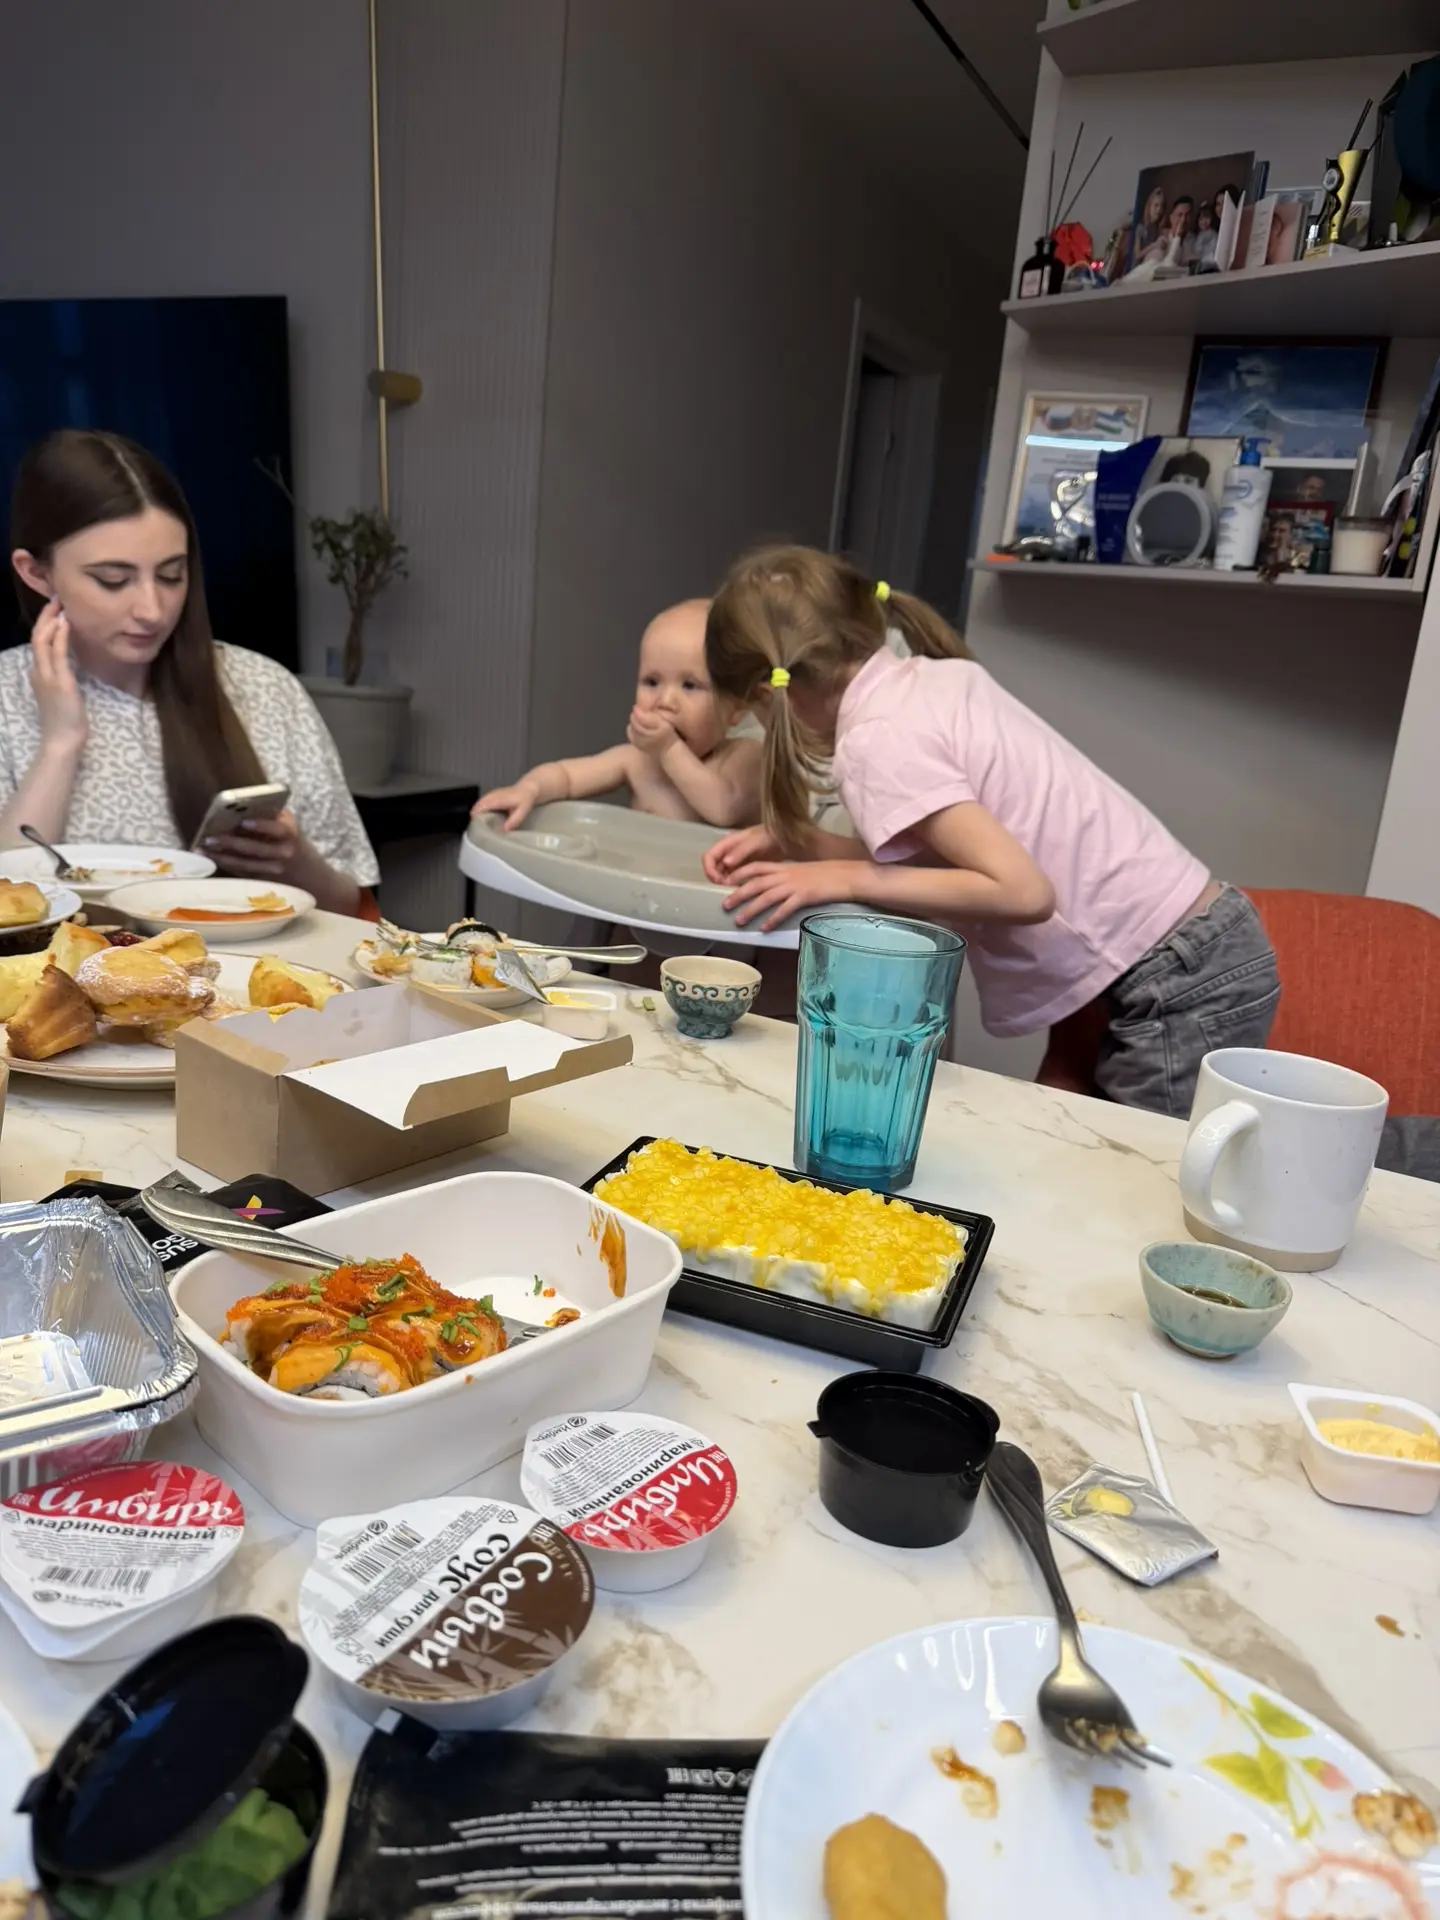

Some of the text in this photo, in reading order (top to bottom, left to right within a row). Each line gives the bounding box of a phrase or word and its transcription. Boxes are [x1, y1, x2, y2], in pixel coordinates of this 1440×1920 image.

[567, 1440, 694, 1519] маринованный
[584, 1457, 725, 1540] Имбирь
[24, 1517, 217, 1541] маринованный
[39, 1485, 234, 1526] Имбирь
[437, 1532, 511, 1593] соус
[409, 1551, 554, 1671] Соевый
[414, 1590, 441, 1617] для
[374, 1611, 416, 1648] суши
